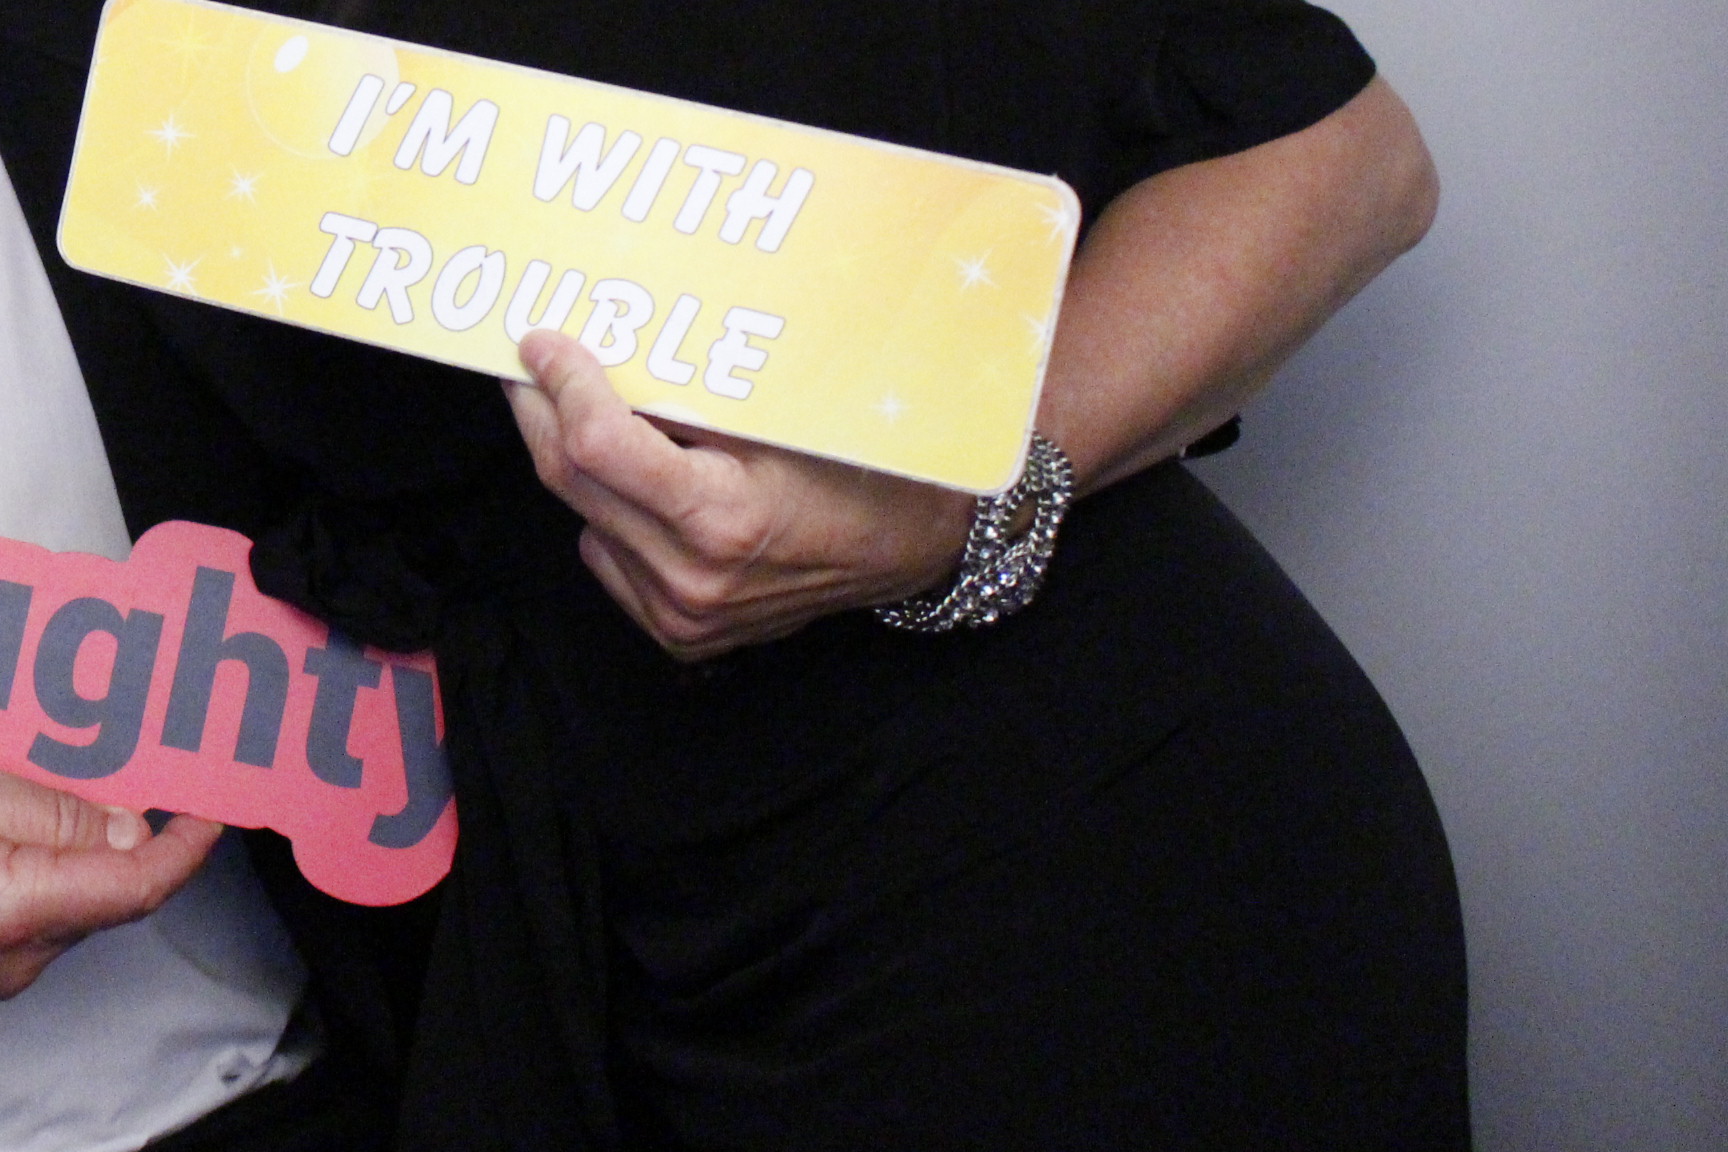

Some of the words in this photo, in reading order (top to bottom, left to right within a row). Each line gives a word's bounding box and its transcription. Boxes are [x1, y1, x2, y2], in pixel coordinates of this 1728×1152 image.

[328, 73, 499, 185] I'M
[533, 113, 815, 253] WITH
[309, 211, 785, 401] TROUBLE
